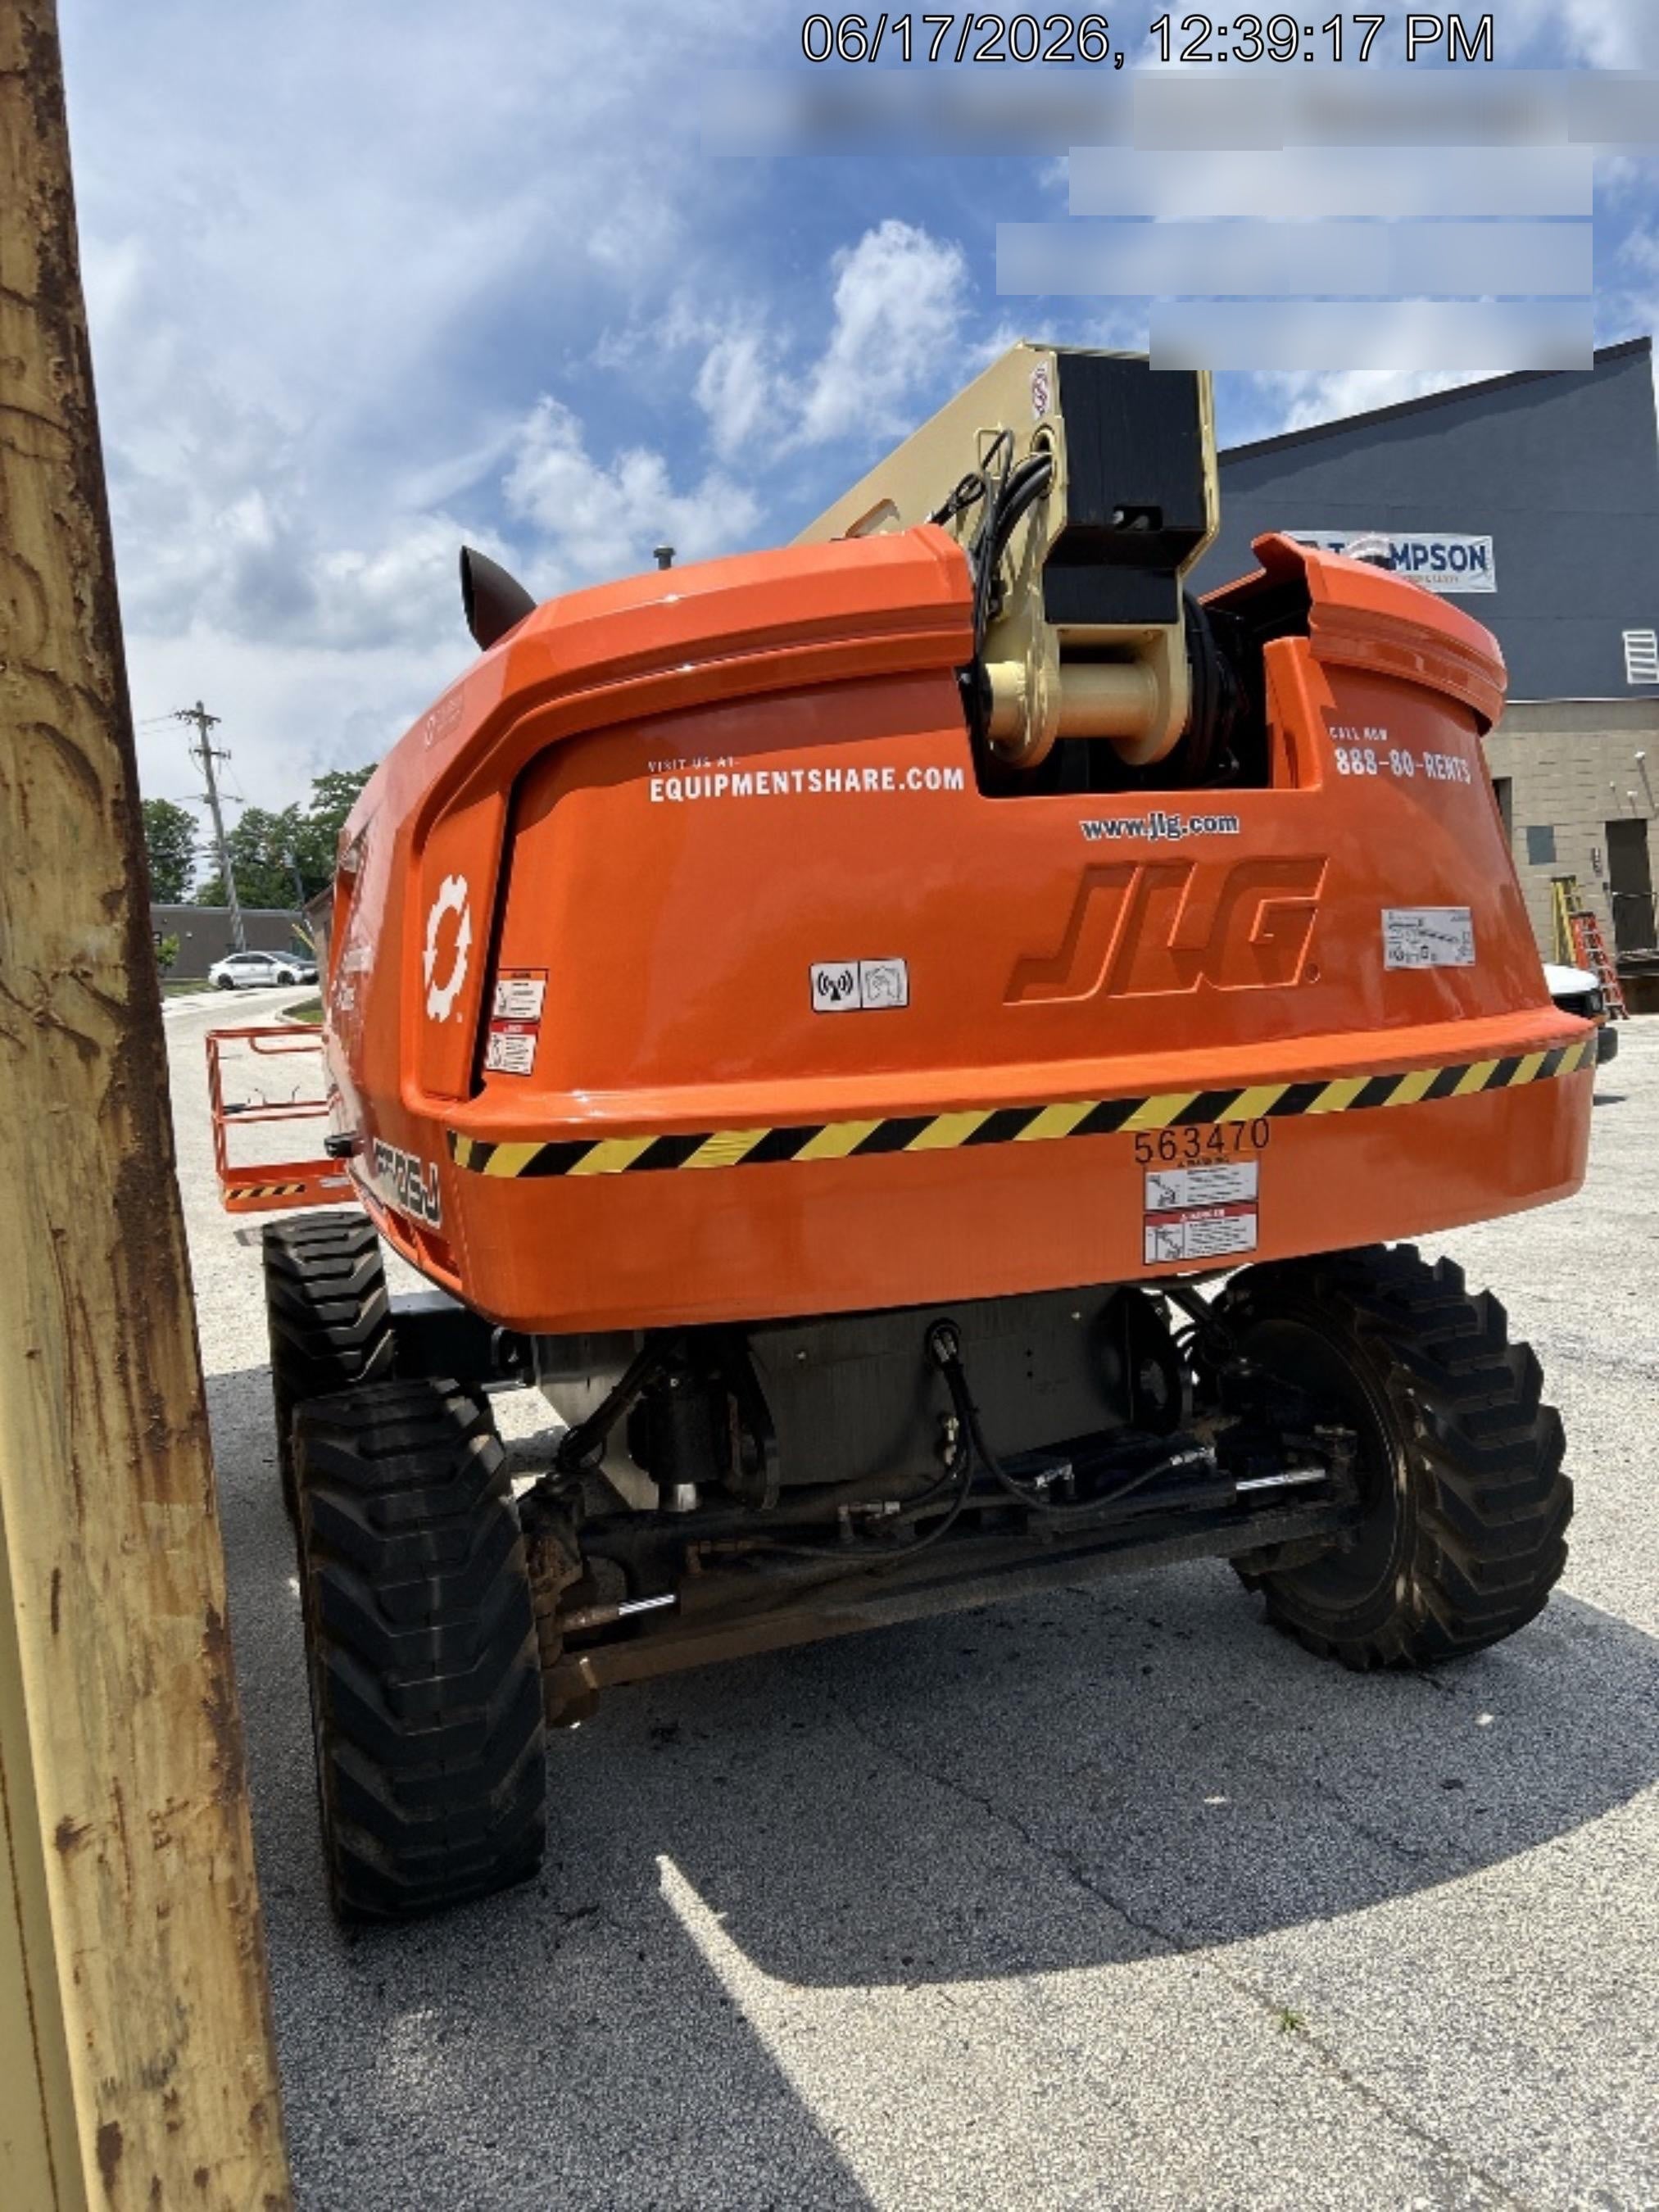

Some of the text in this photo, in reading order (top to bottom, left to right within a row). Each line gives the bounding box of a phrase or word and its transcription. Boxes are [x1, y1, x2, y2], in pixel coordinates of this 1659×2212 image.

[648, 758, 687, 773] VISIT
[692, 755, 712, 769] US
[1334, 746, 1471, 785] 888-80-RENTS
[650, 768, 964, 803] EQUIPMENTSHARE.COM
[1079, 812, 1240, 841] www.jlg.com
[1002, 854, 1330, 1006] JLG
[1134, 1117, 1270, 1165] 563470
